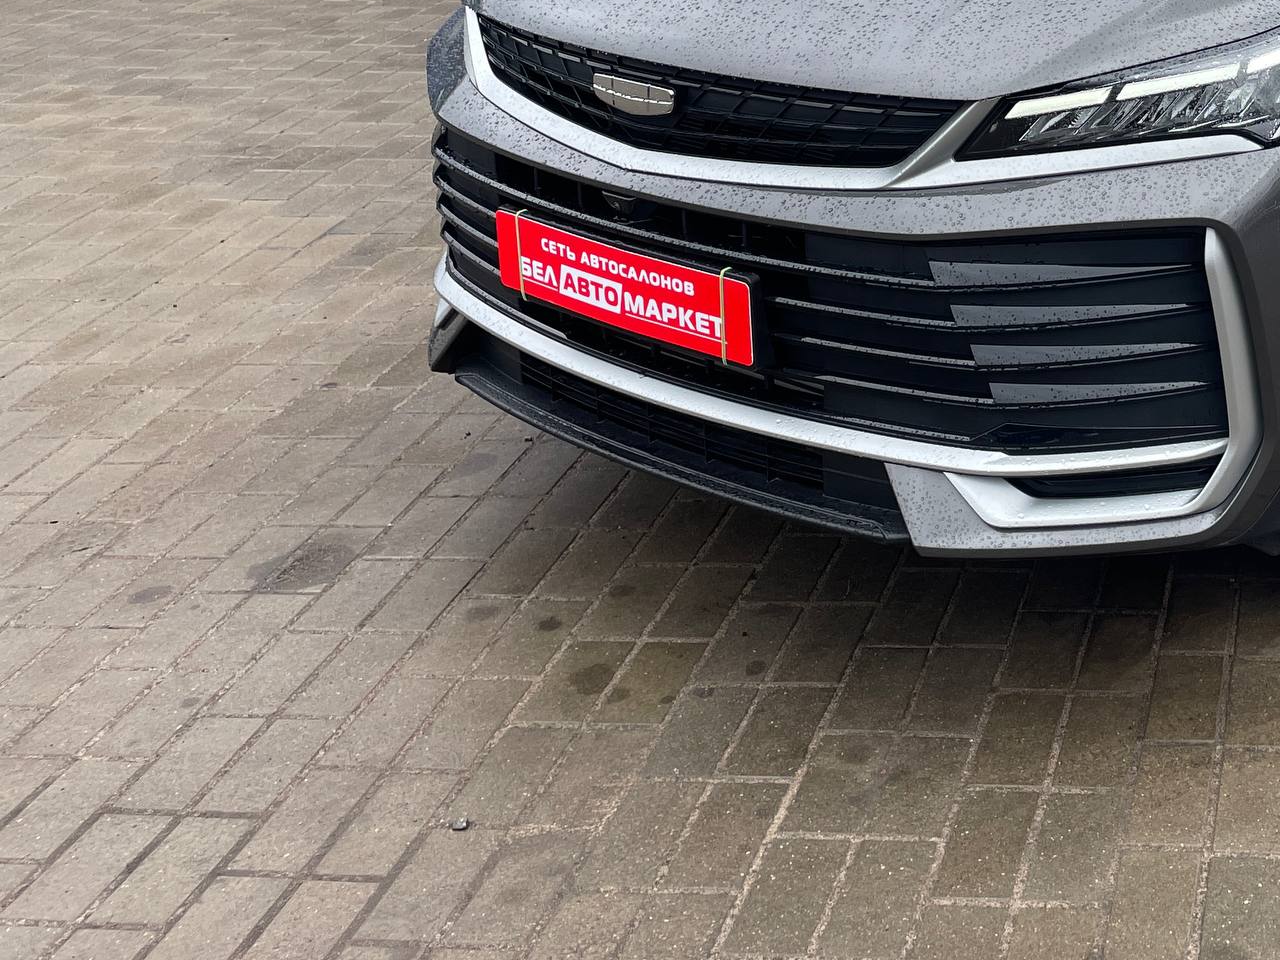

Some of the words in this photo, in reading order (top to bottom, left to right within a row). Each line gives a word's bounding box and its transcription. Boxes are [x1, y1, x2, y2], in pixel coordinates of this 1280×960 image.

[520, 255, 558, 287] БЕЛ
[563, 272, 620, 306] АВТО
[623, 291, 723, 337] МАРКЕТ
[540, 238, 576, 262] СЕТЬ
[580, 251, 695, 297] АВТОСАЛОНОВ
